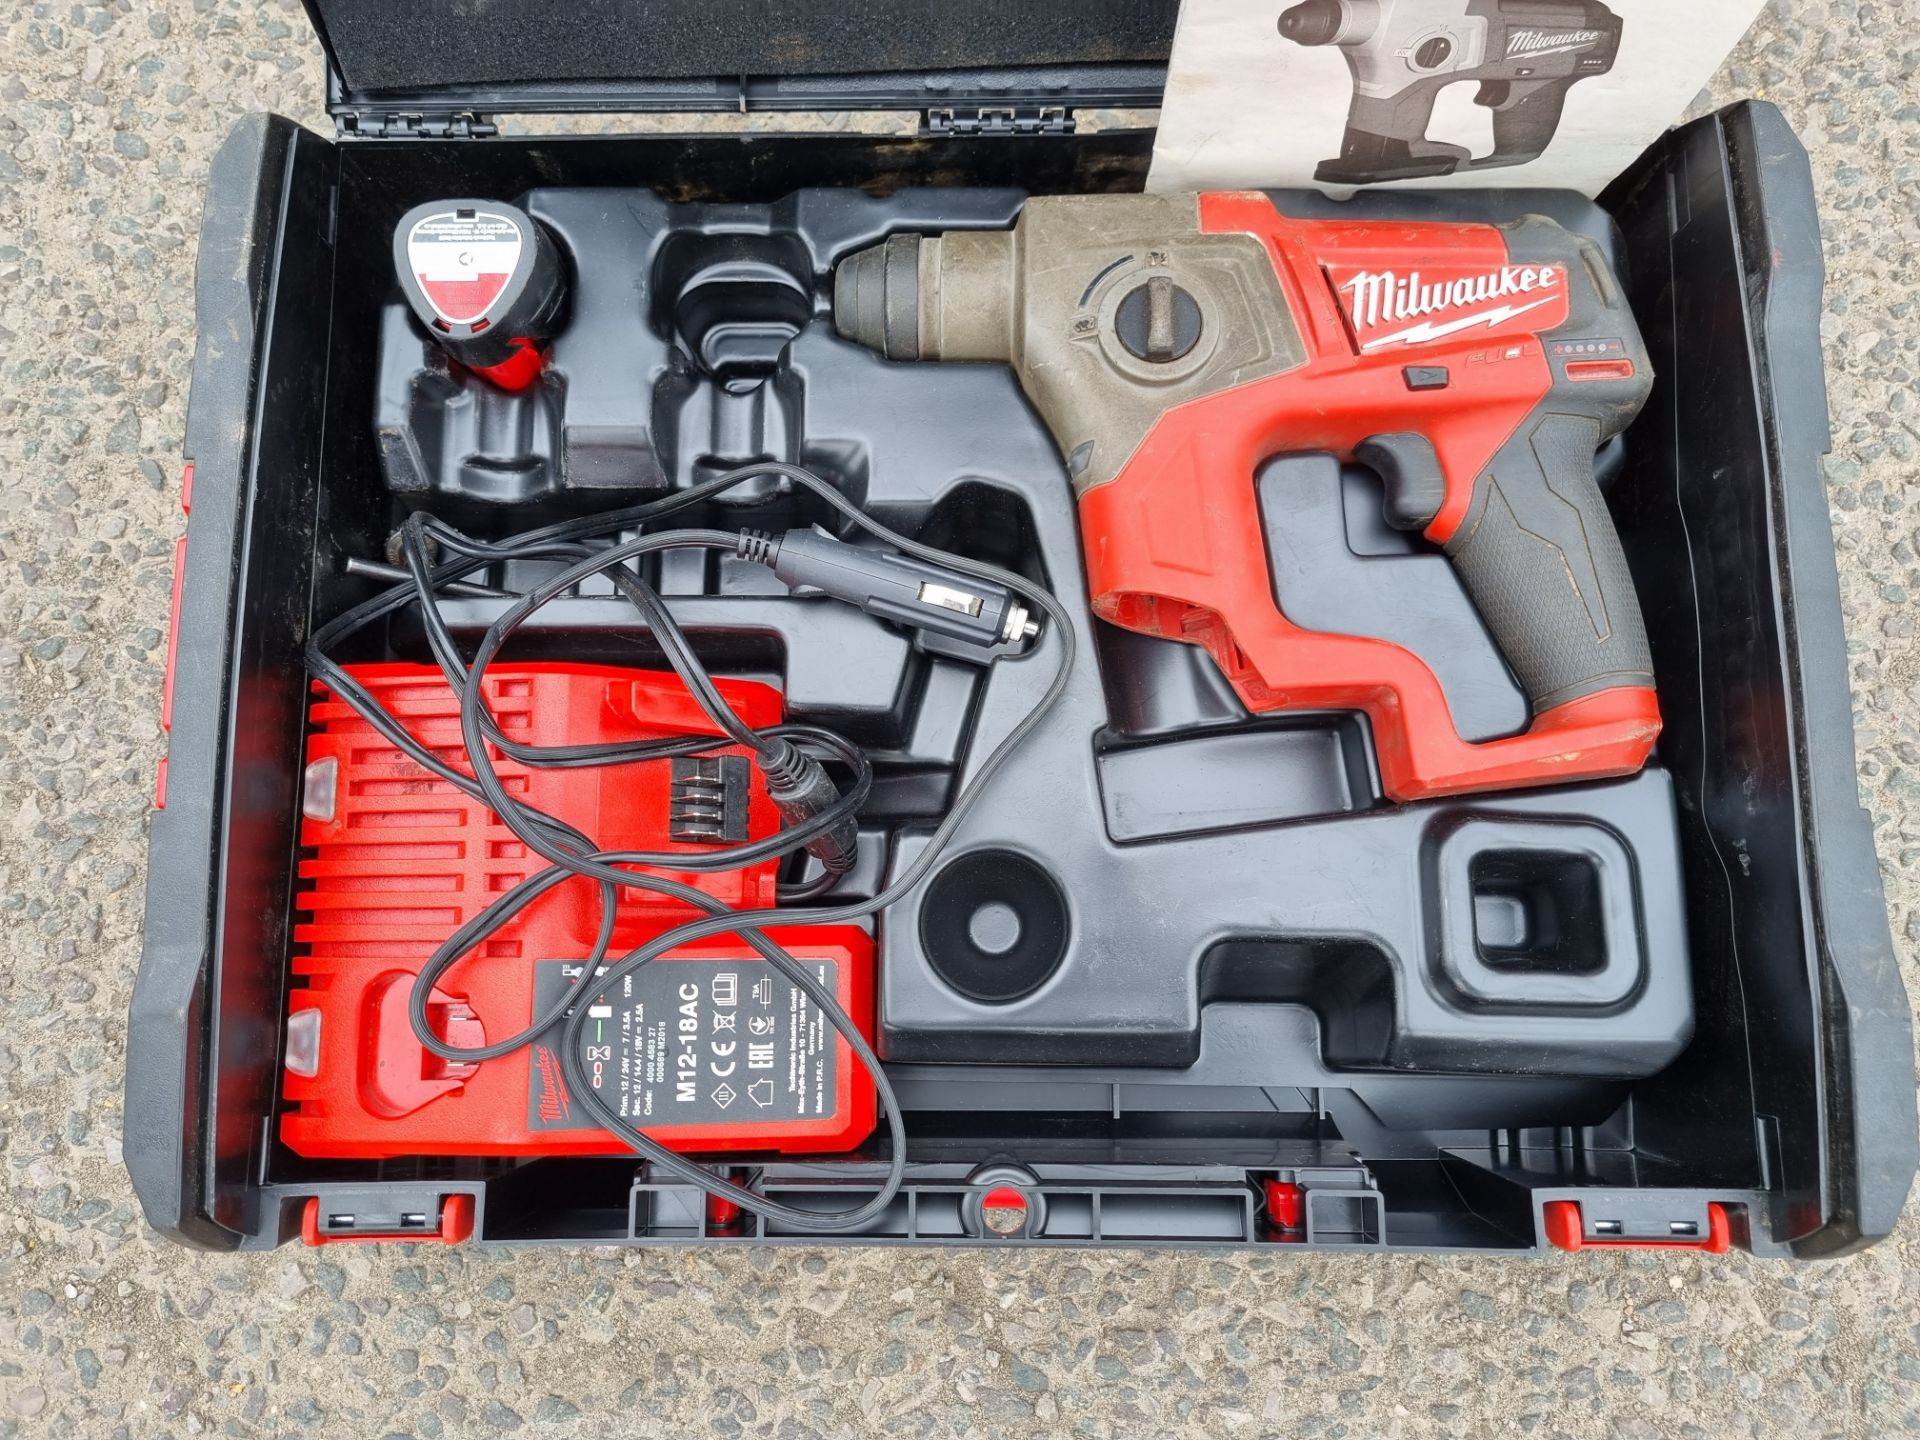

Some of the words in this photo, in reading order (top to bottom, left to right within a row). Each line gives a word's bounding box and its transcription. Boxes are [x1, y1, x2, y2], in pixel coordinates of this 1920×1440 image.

[1506, 29, 1599, 53] Milwaukee
[1340, 266, 1561, 333] Milwaukee
[624, 974, 632, 997] 120W
[790, 988, 798, 1012] GmbH
[623, 1011, 631, 1030] 3.5A
[635, 1004, 643, 1022] 2.5A
[648, 1027, 655, 1036] 27
[658, 1021, 666, 1050] M2018
[676, 983, 699, 1102] M12-18AC
[789, 1013, 797, 1051] Industries
[808, 1021, 816, 1055] Germany
[635, 1036, 643, 1051] 18V
[799, 1039, 806, 1048] 10
[634, 1059, 642, 1076] 14.4
[646, 1062, 655, 1083] 4000
[788, 1053, 796, 1092] Techtronic
[536, 1045, 562, 1123] Milwaukee
[621, 1081, 629, 1091] 12
[634, 1085, 641, 1094] 12
[620, 1094, 629, 1116] Prim.
[633, 1097, 641, 1116] Sec.
[644, 1090, 653, 1115] Code:
